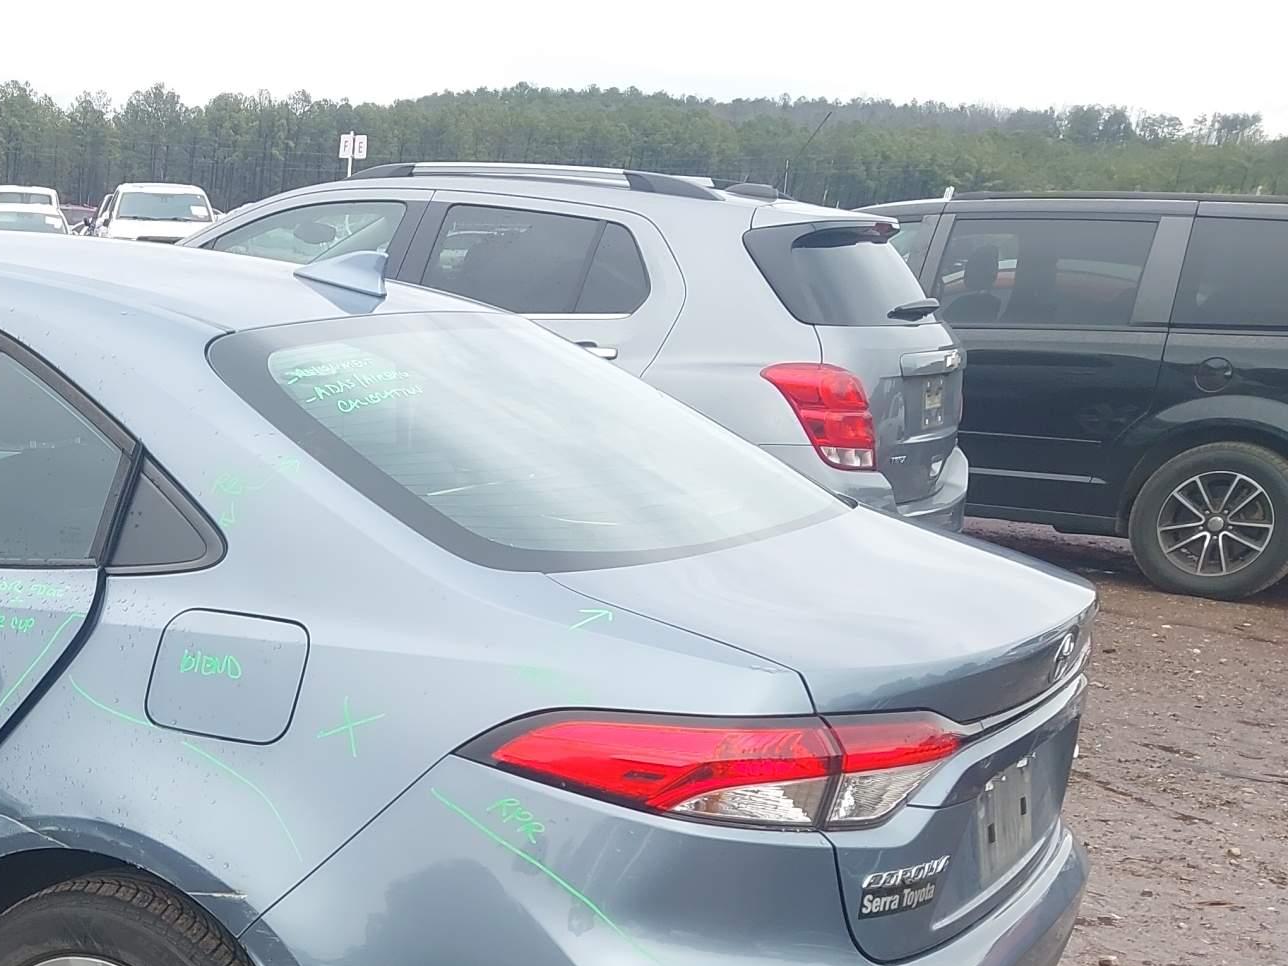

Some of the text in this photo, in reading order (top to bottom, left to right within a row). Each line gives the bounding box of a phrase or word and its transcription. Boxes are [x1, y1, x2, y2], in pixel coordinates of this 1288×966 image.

[358, 141, 364, 154] E
[10, 616, 36, 633] CUP
[861, 882, 936, 914] Serra Toyota
